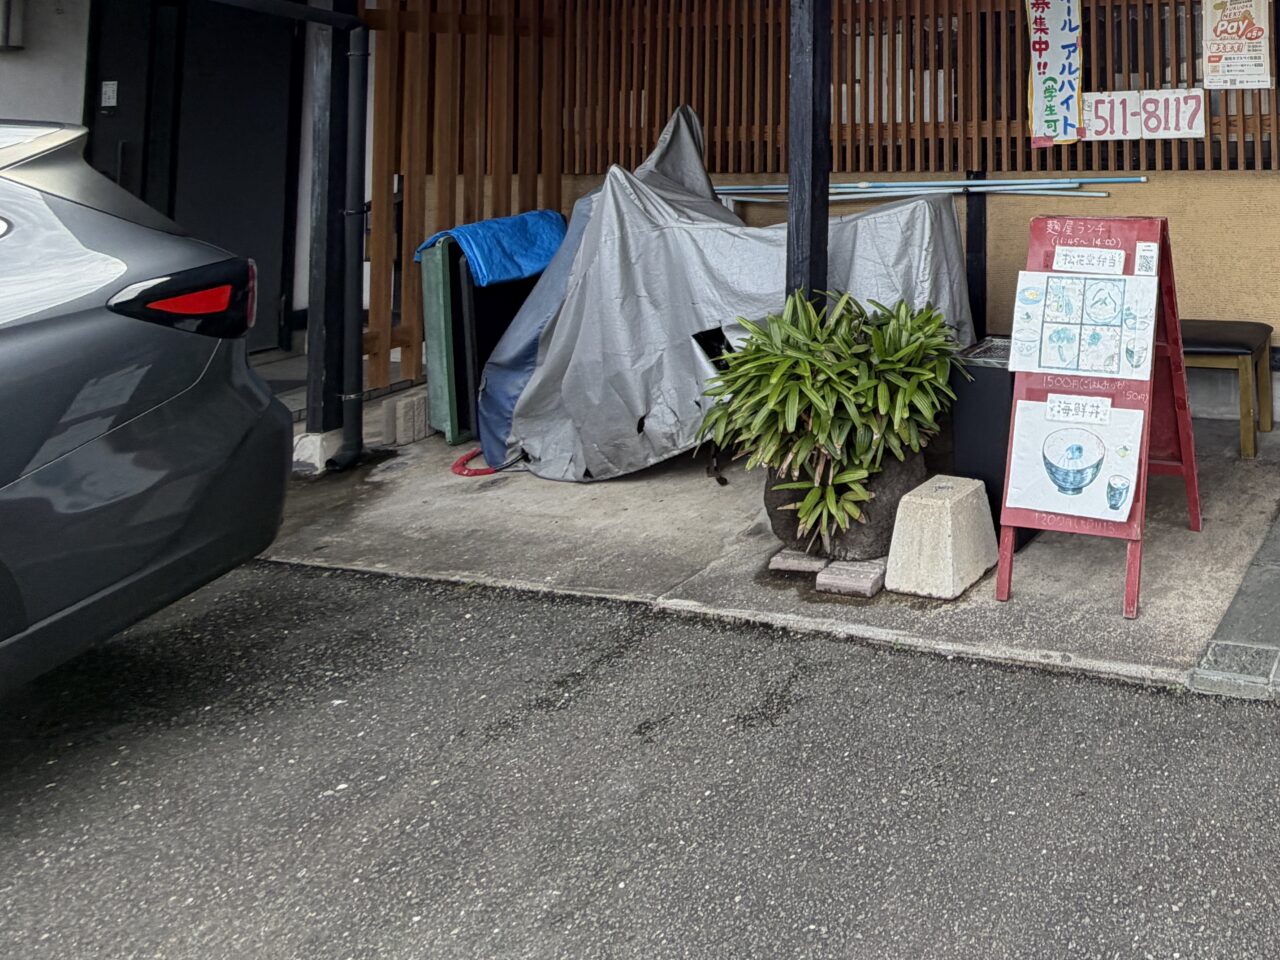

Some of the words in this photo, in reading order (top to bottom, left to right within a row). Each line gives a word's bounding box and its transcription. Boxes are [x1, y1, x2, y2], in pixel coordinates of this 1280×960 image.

[1222, 11, 1242, 19] NEXT
[1094, 95, 1202, 136] 511-8117
[1062, 253, 1116, 268] 松花堂弁当
